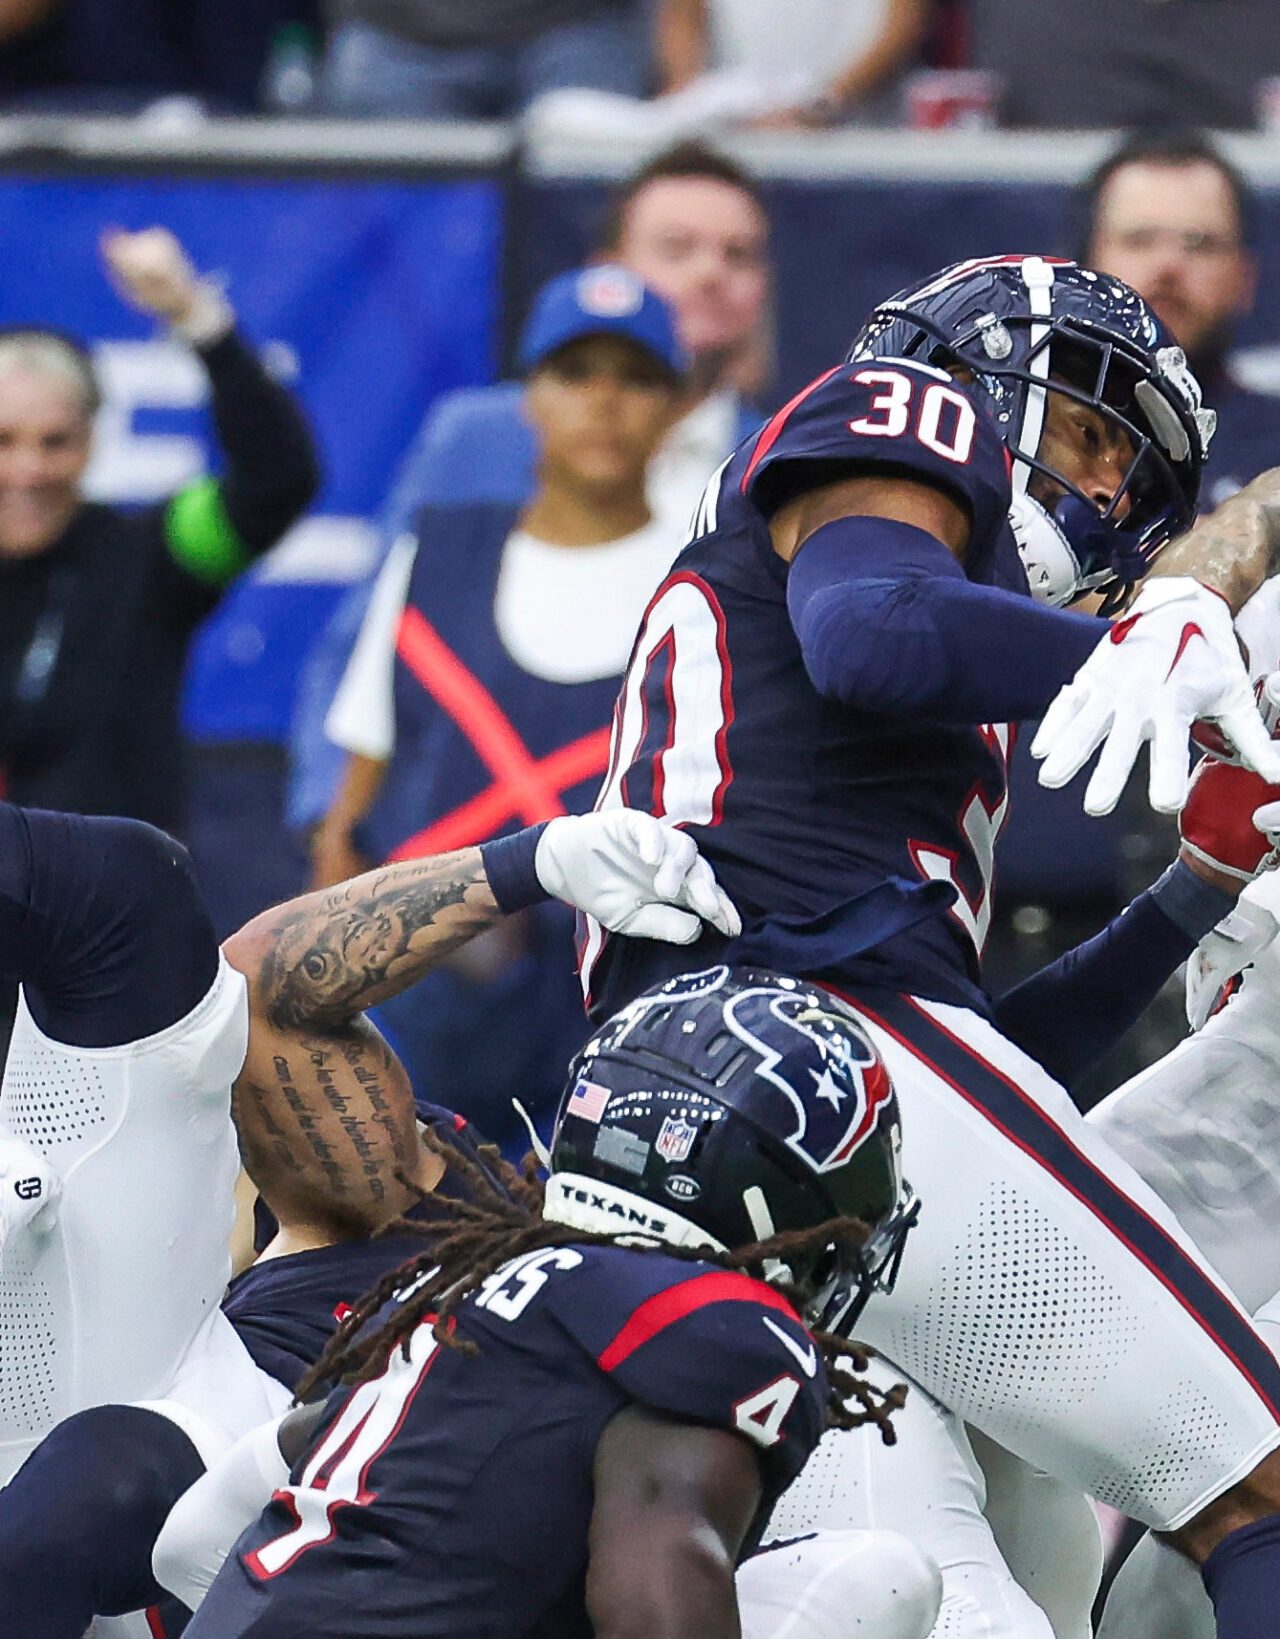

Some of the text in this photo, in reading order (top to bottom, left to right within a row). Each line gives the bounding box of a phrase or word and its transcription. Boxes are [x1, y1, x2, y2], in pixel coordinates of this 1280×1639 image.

[848, 369, 978, 465] 30
[561, 1184, 667, 1233] TEXANS
[730, 1371, 804, 1449] 4
